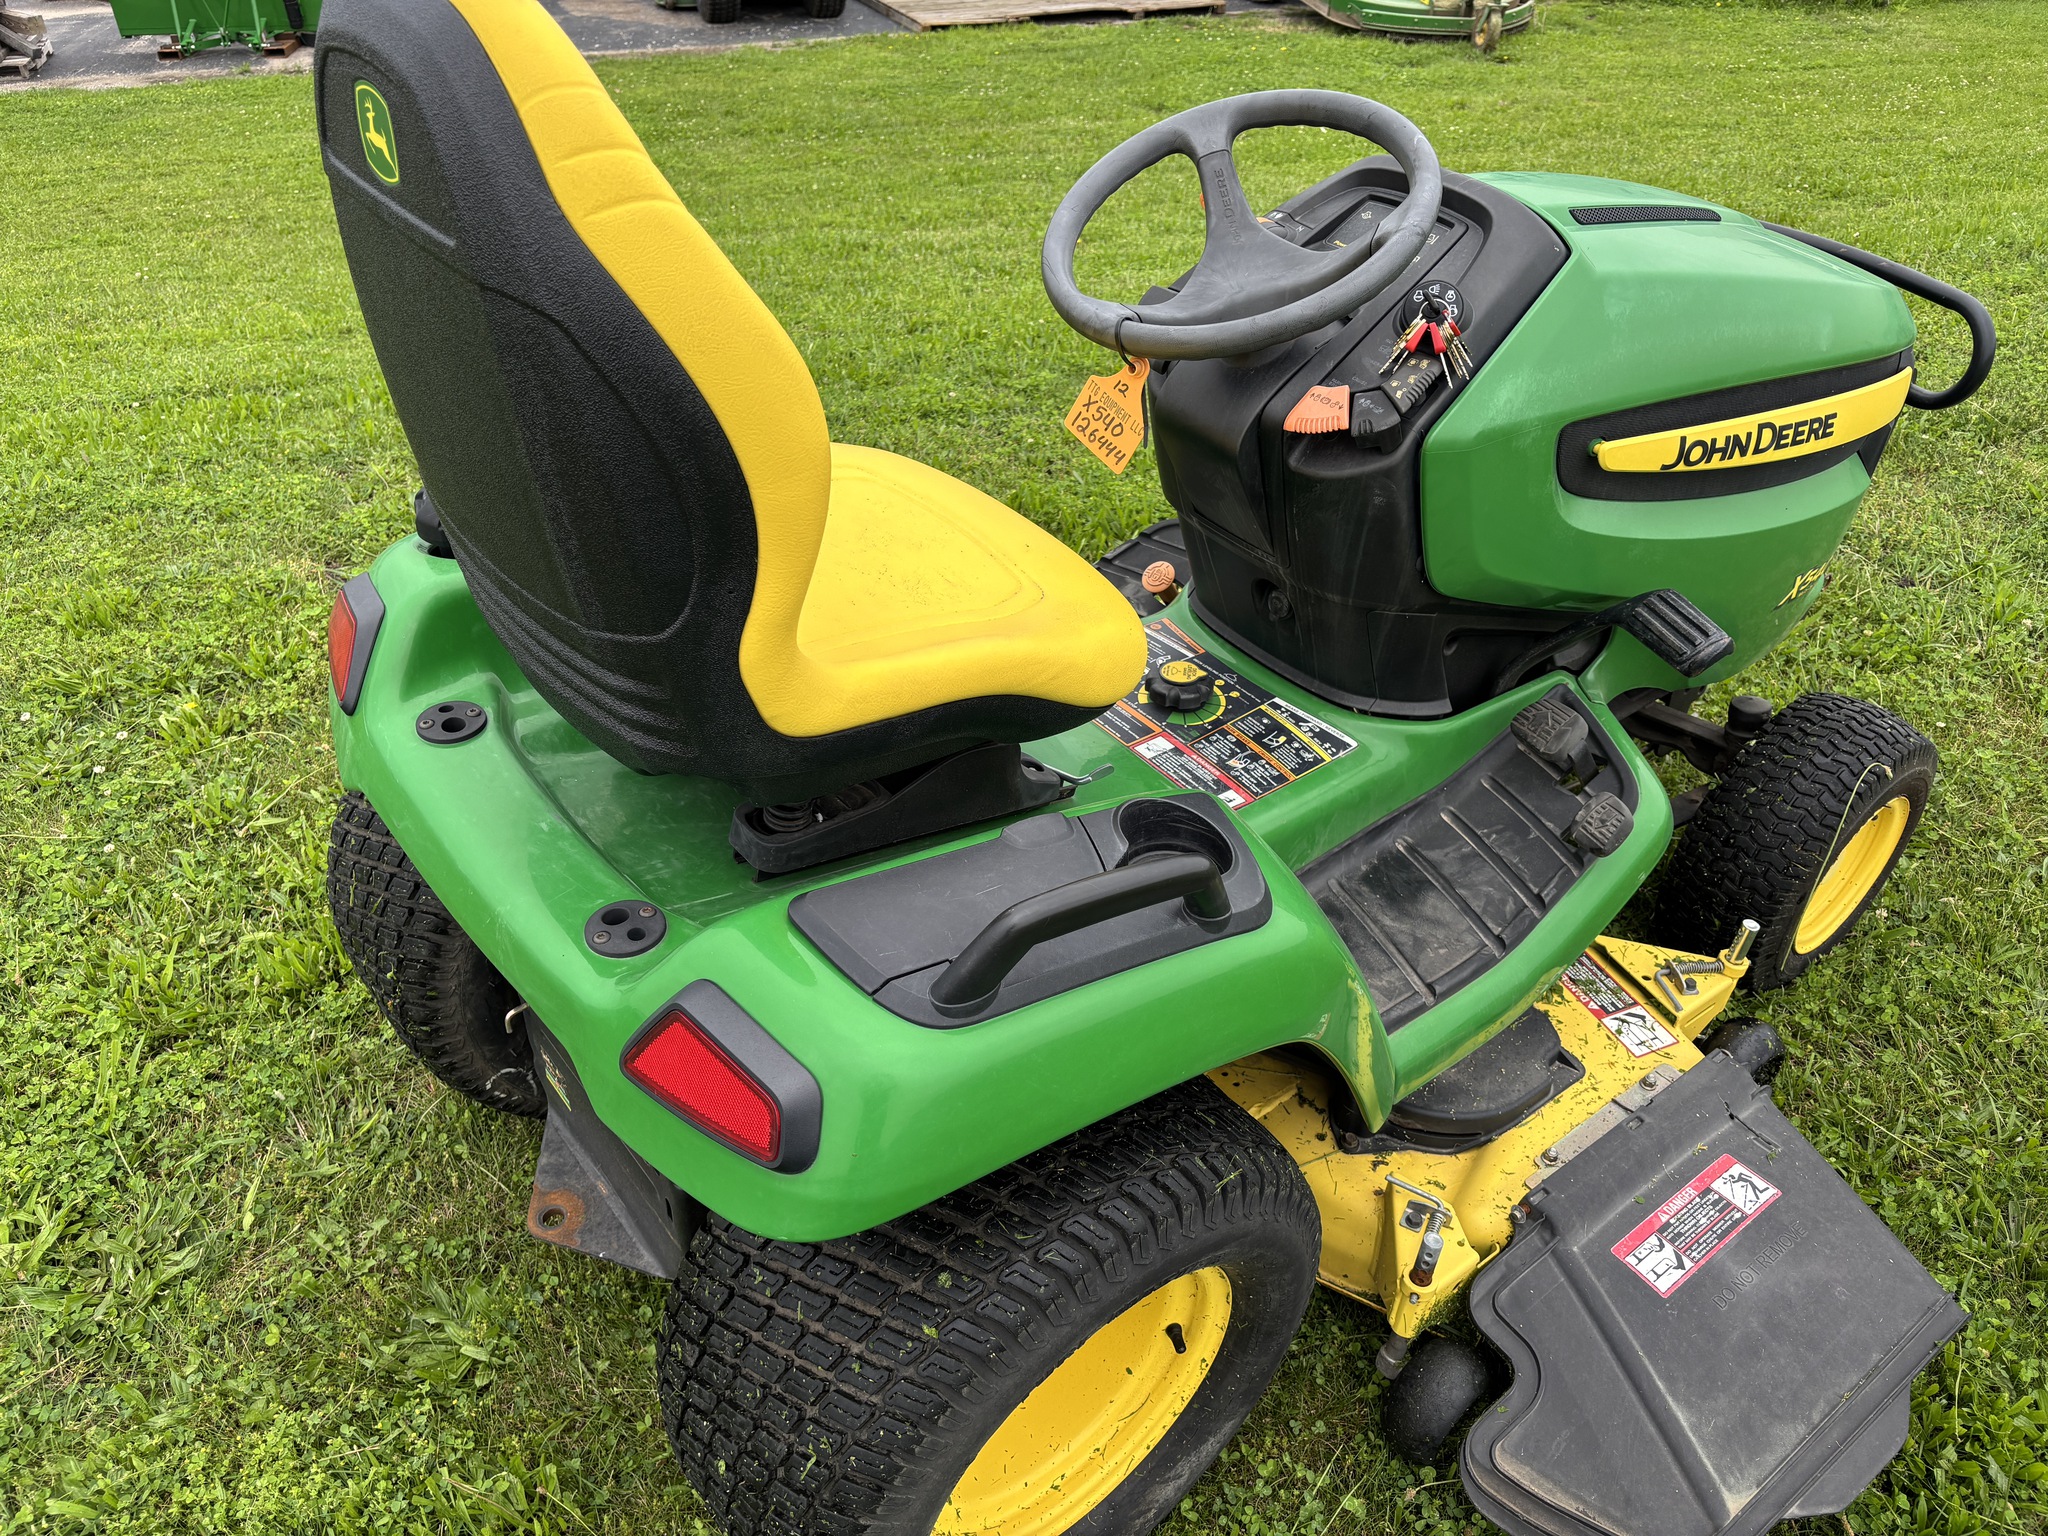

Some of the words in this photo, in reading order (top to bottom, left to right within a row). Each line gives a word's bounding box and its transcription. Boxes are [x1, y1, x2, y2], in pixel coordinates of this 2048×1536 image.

[1214, 168, 1235, 218] DEERE
[1088, 380, 1100, 396] TTG
[1099, 391, 1131, 424] EQUIPMENT
[1130, 420, 1144, 436] LLC
[1113, 380, 1129, 398] 12
[1071, 411, 1126, 465] 126444
[1082, 394, 1124, 437] X540
[1660, 431, 1752, 470] JOHN
[1752, 412, 1837, 455] DEERE
[1196, 756, 1220, 776] DANGER
[1562, 974, 1590, 1003] DANGE
[1663, 1186, 1698, 1215] DANGER
[1712, 1288, 1736, 1309] DO
[1731, 1263, 1760, 1291] NOT
[1755, 1222, 1807, 1268] REMOVE
